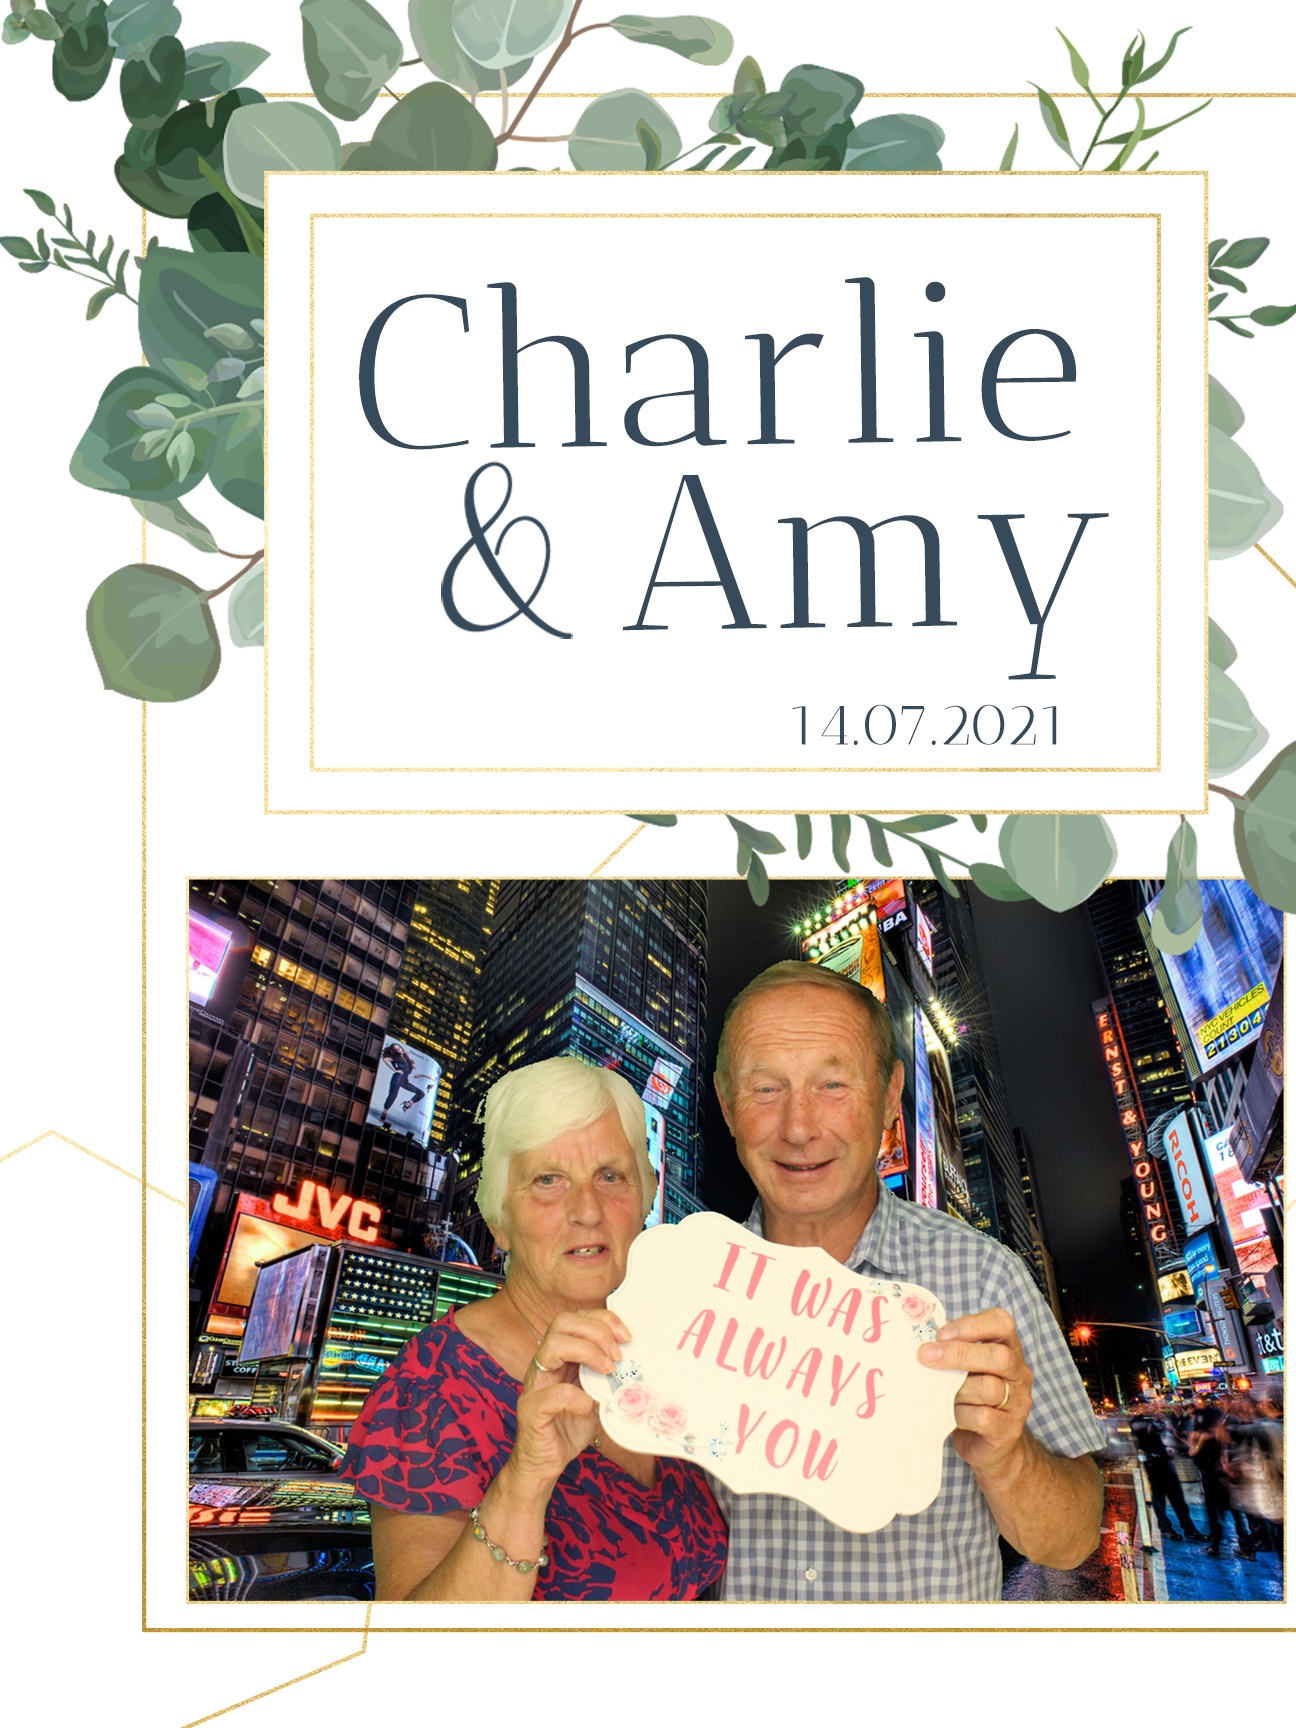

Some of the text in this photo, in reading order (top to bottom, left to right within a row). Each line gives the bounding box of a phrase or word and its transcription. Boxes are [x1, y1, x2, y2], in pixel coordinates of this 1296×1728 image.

[1200, 984, 1265, 1036] NYC VEHICLES
[1203, 1016, 1234, 1043] COUNT
[1097, 1013, 1168, 1242] ERNST & YOUNG
[273, 1179, 381, 1242] JVC
[1169, 1129, 1199, 1223] RICOH
[712, 1241, 890, 1343] IT WAS
[676, 1309, 885, 1419] ALWAYS
[735, 1403, 839, 1481] YOU
